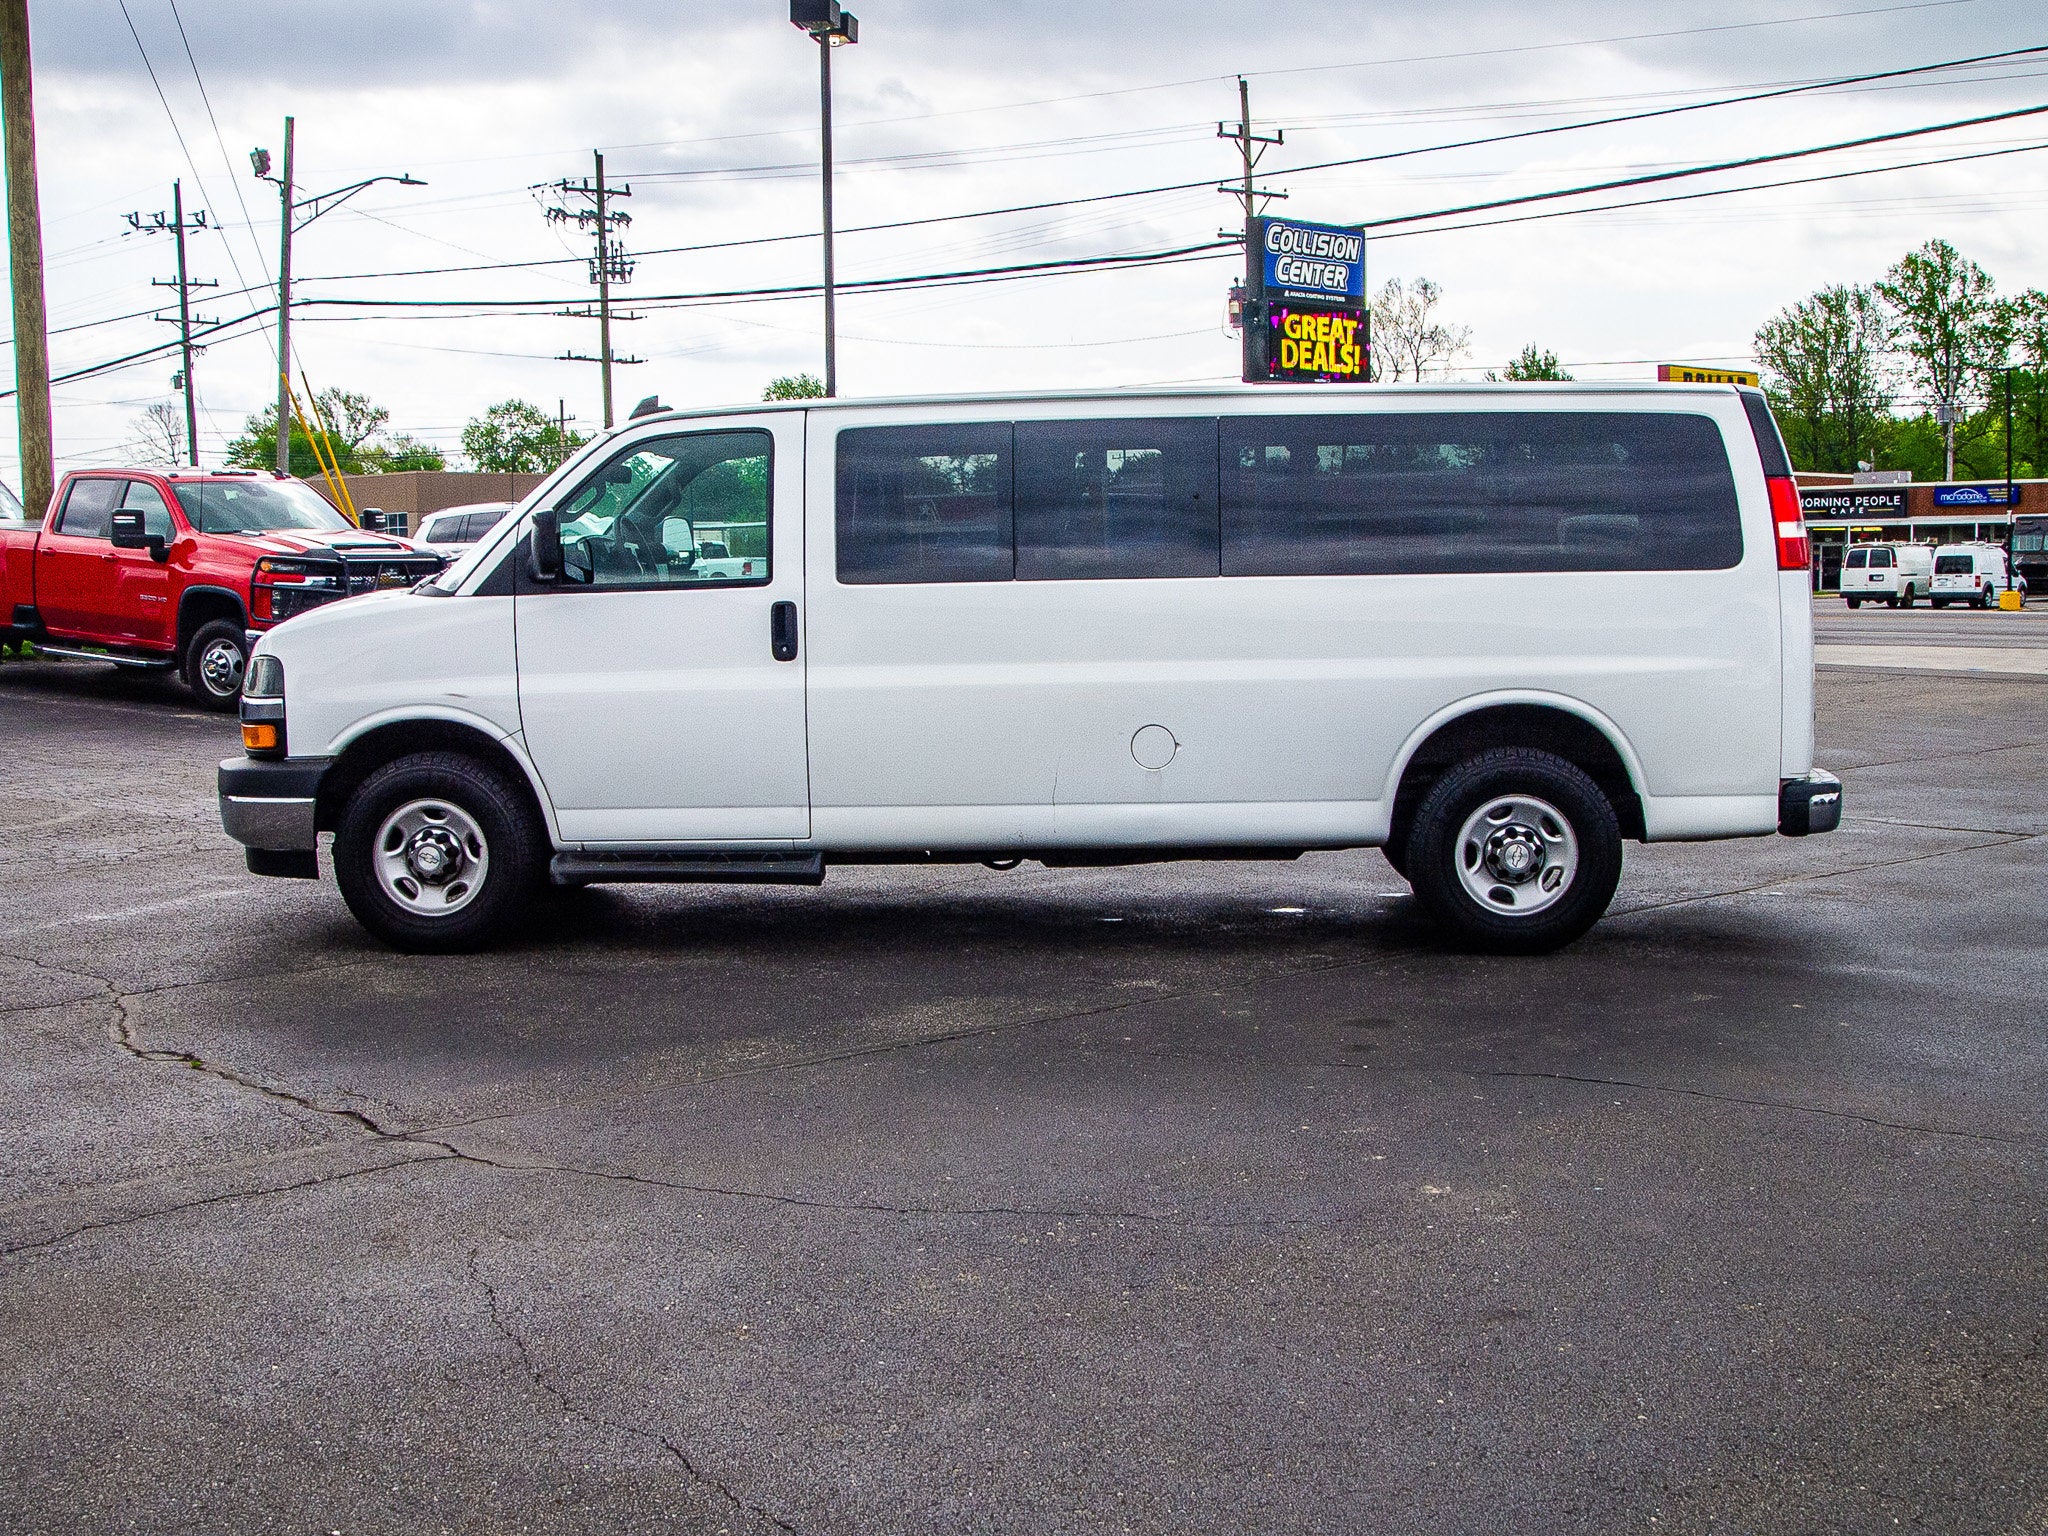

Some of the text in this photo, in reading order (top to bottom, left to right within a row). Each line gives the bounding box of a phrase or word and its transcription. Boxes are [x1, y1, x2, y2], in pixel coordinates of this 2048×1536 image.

[1265, 223, 1361, 262] COLLISION
[1276, 254, 1348, 290] CENTER
[1284, 313, 1358, 345] GREAT
[1281, 338, 1361, 375] DEALS!
[1855, 495, 1902, 507] PEOPLE
